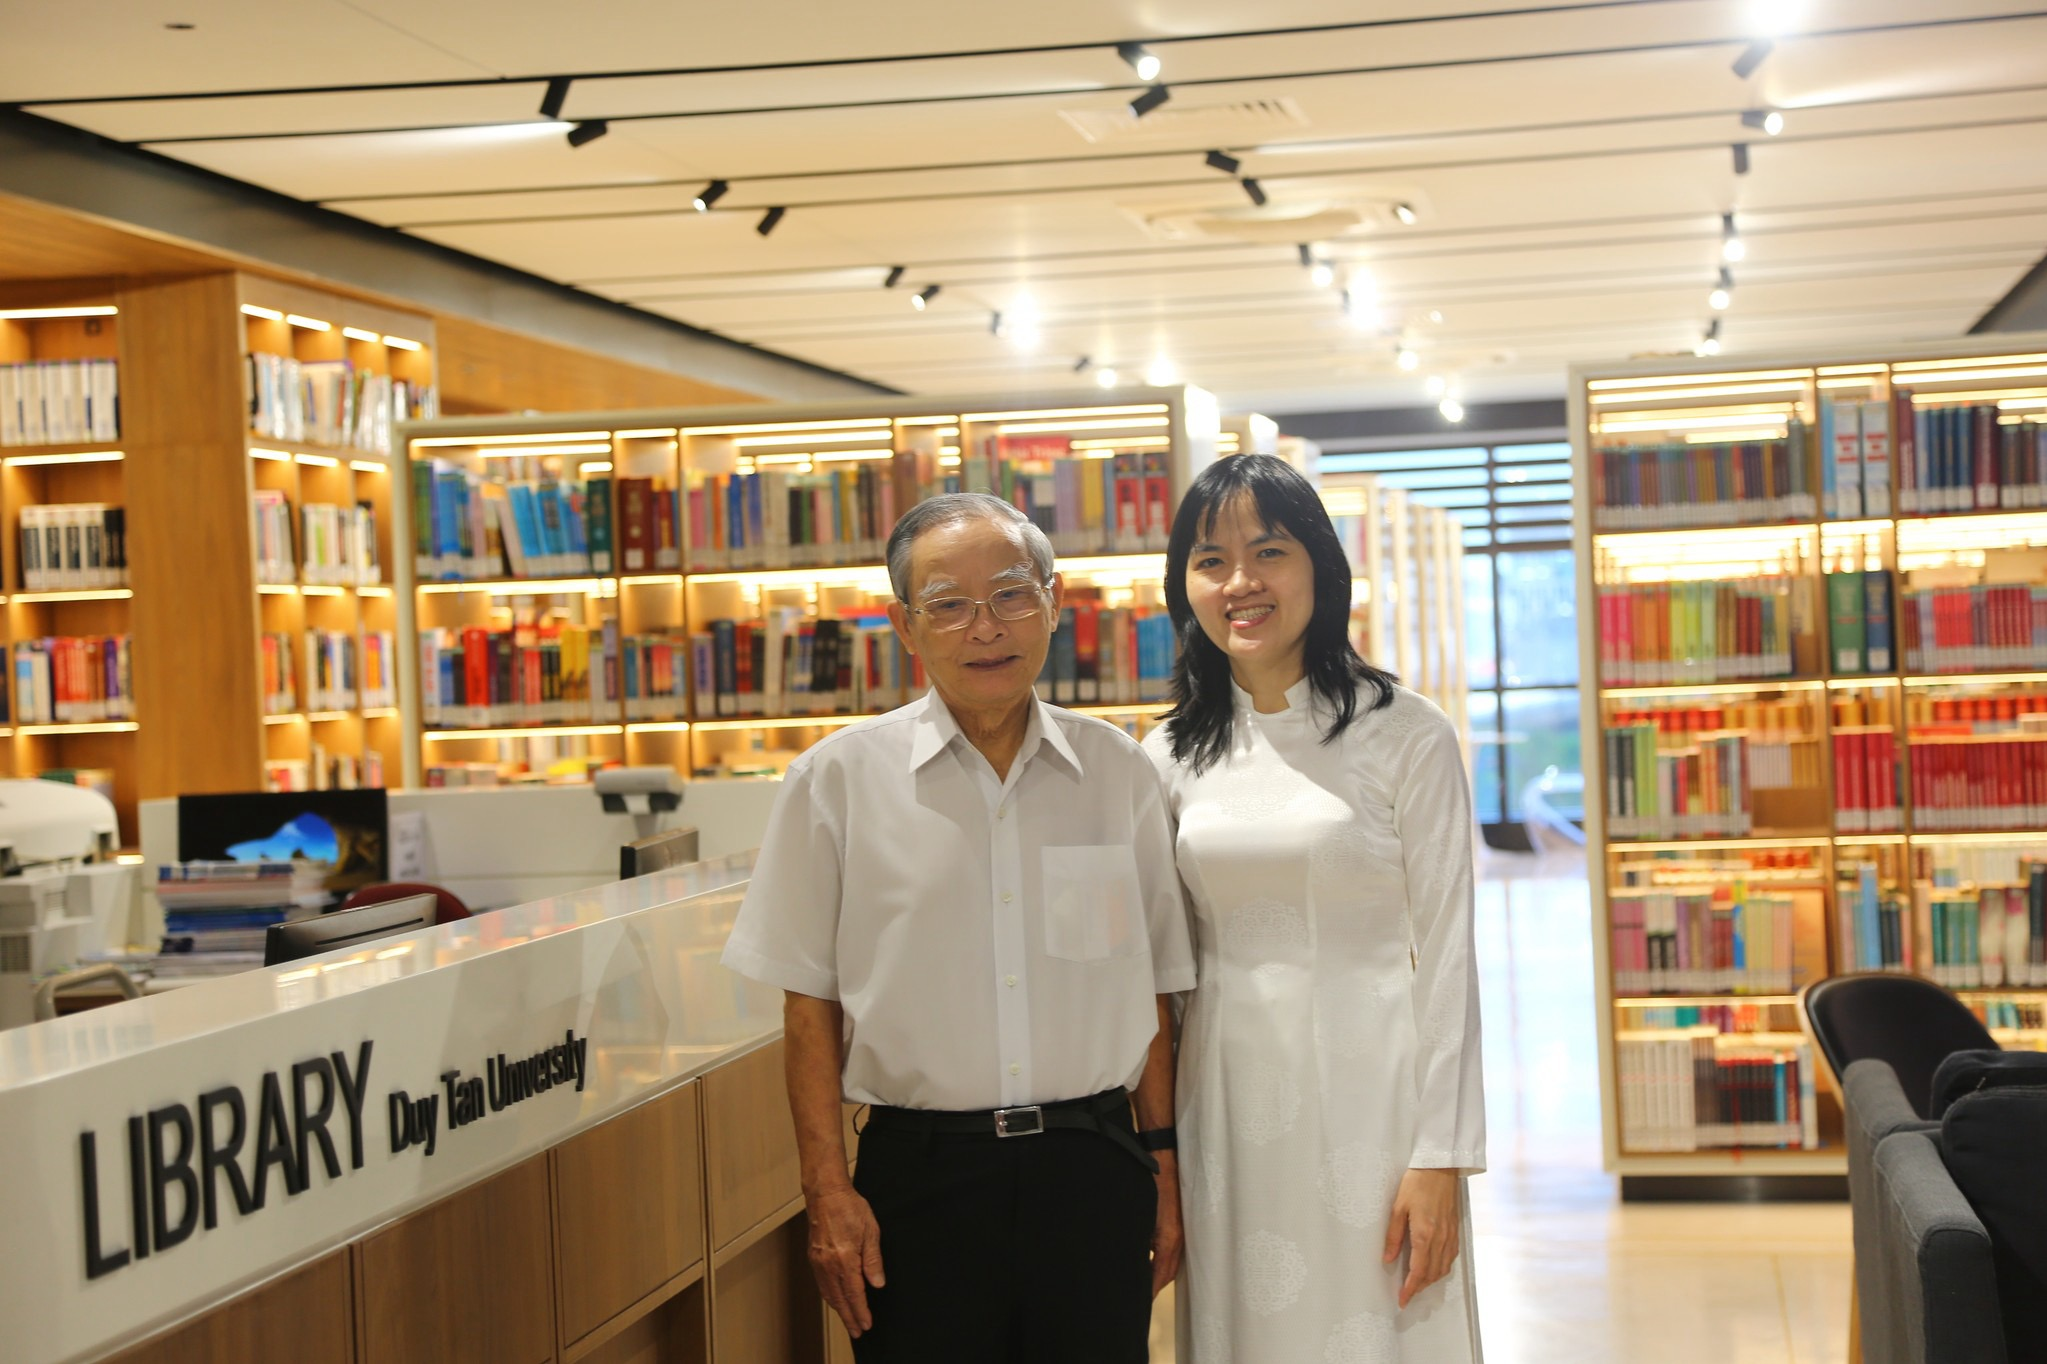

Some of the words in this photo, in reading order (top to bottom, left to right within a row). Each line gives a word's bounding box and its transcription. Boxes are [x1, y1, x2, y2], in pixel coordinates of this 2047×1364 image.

[80, 1040, 374, 1280] LIBRARY
[389, 1091, 439, 1156] Duy
[440, 1069, 486, 1130] Tan
[487, 1029, 587, 1112] University
